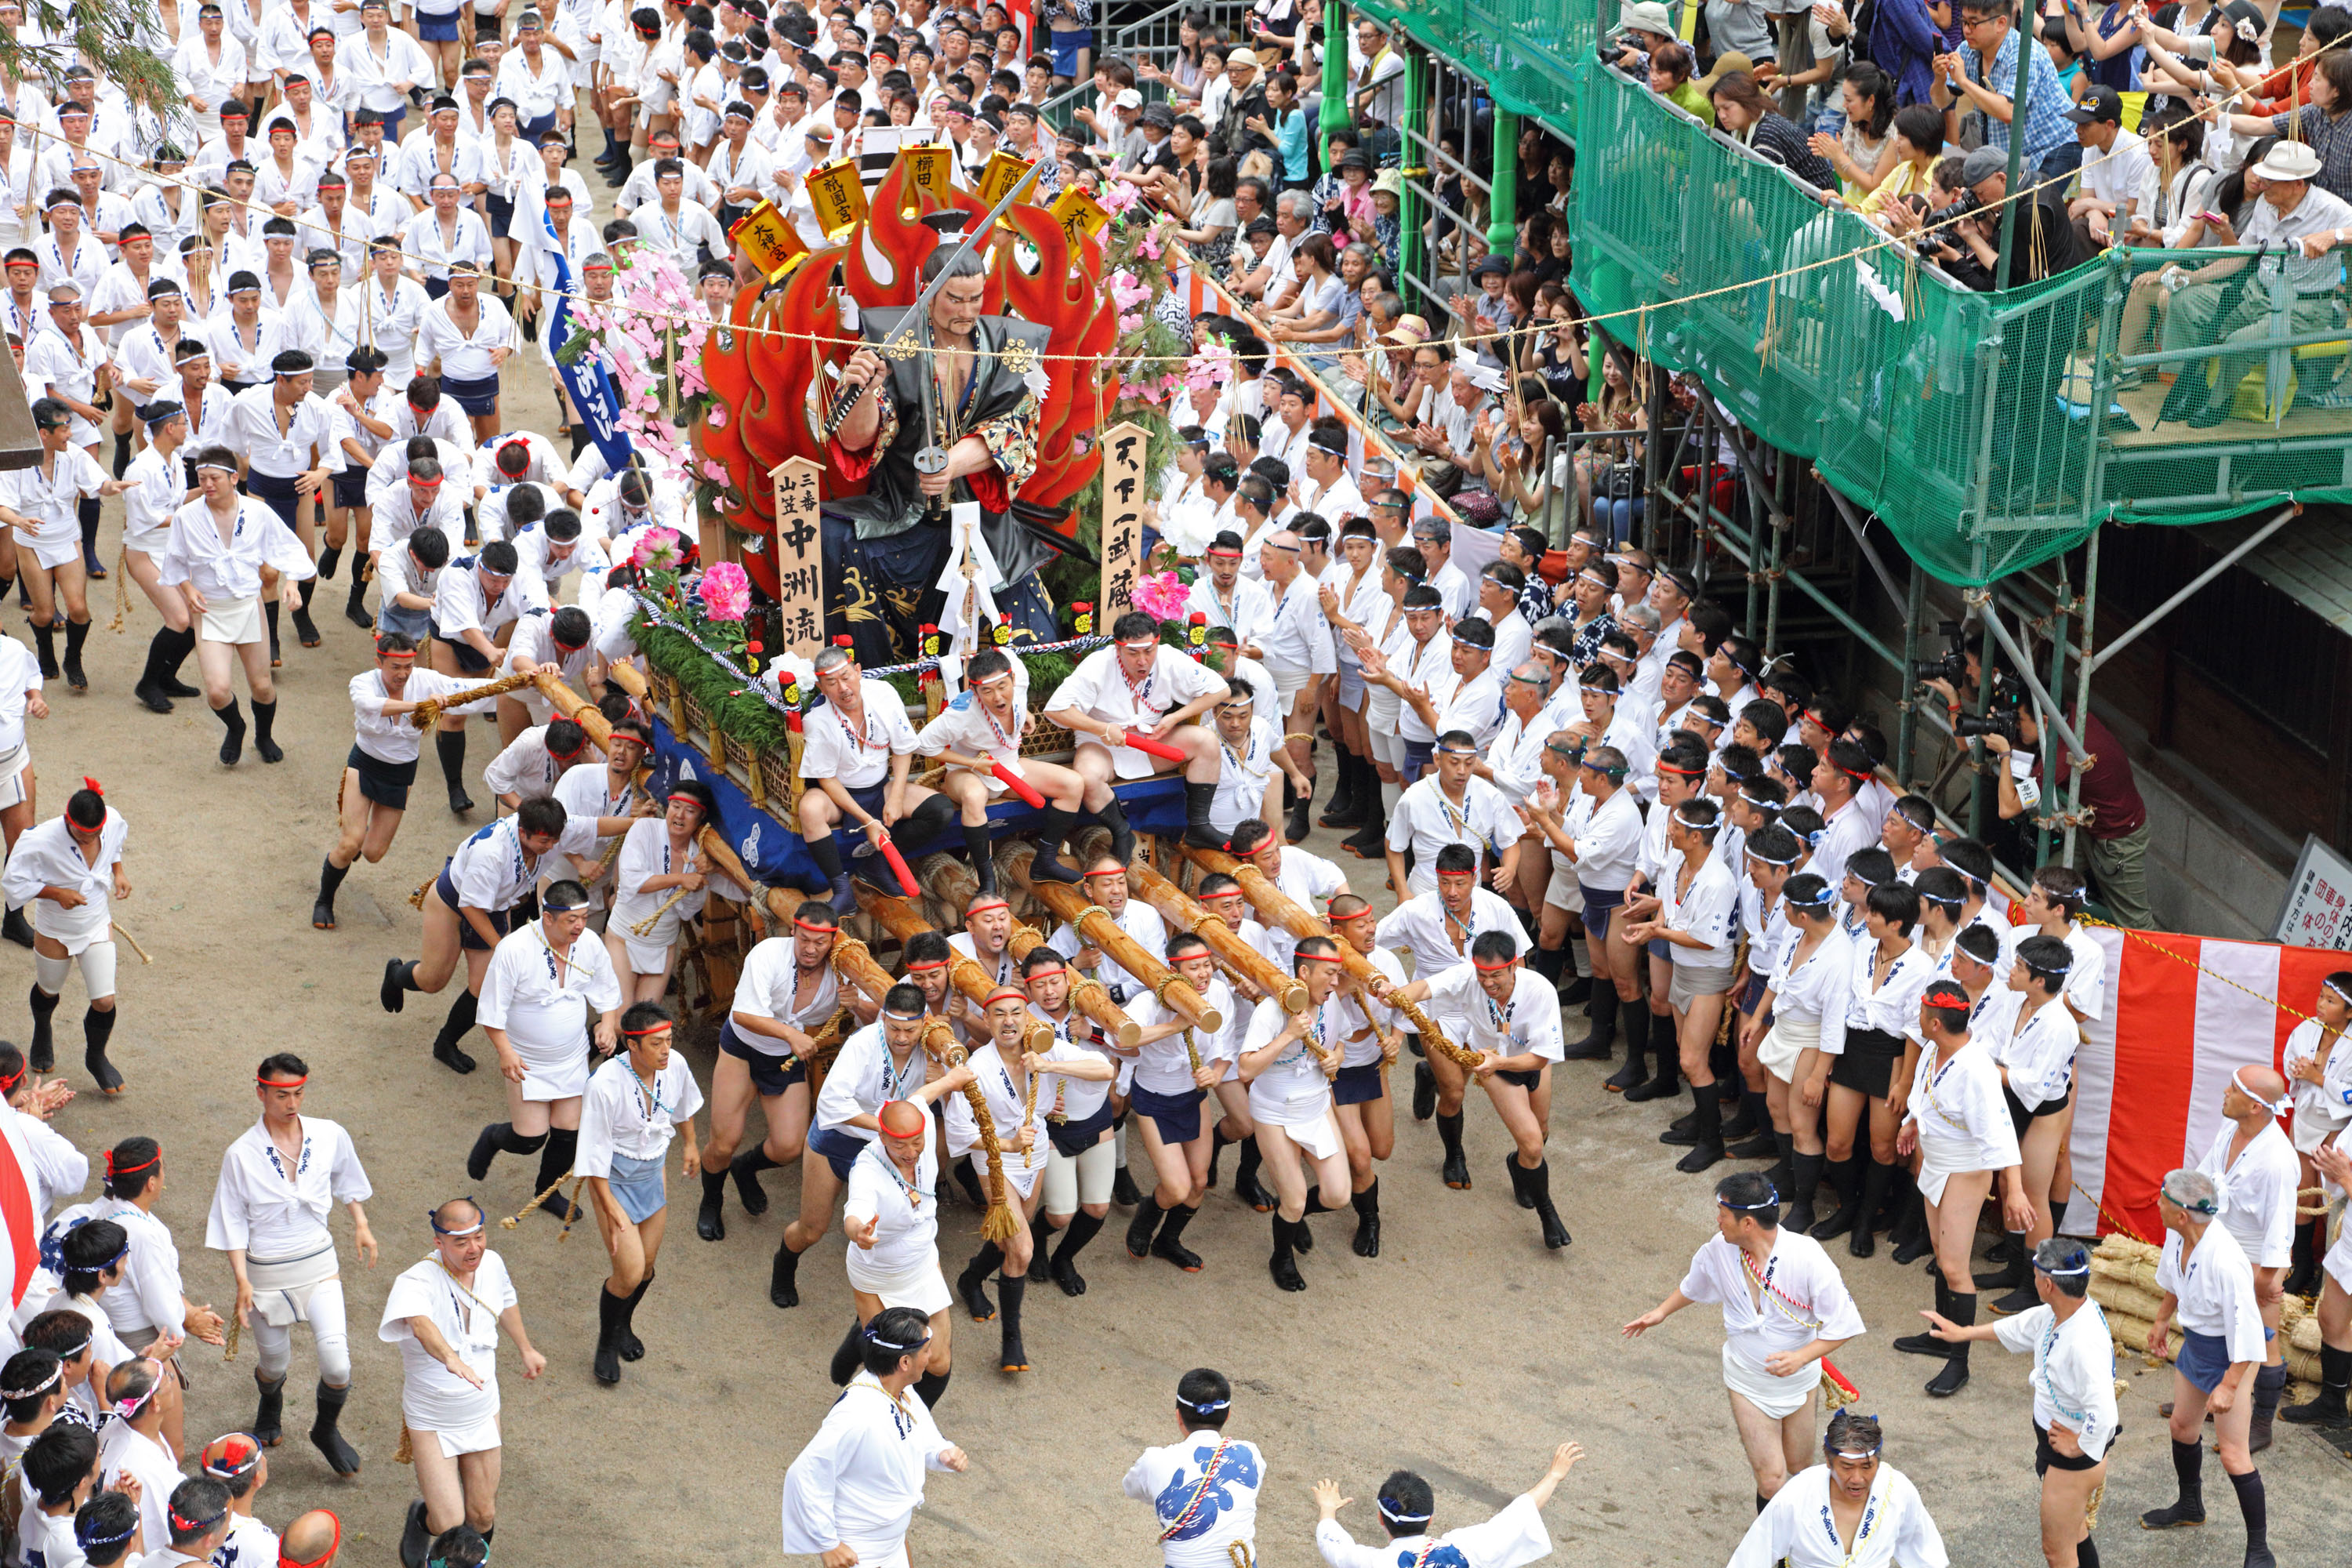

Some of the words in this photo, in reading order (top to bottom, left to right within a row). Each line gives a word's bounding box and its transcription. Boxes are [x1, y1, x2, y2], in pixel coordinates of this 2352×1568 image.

[916, 156, 935, 191] 櫛田
[753, 223, 787, 262] 大神宮
[779, 476, 798, 515] 山笠
[800, 474, 817, 511] 三番
[1107, 437, 1139, 612] 天下一武蔵
[782, 518, 823, 646] 中洲流
